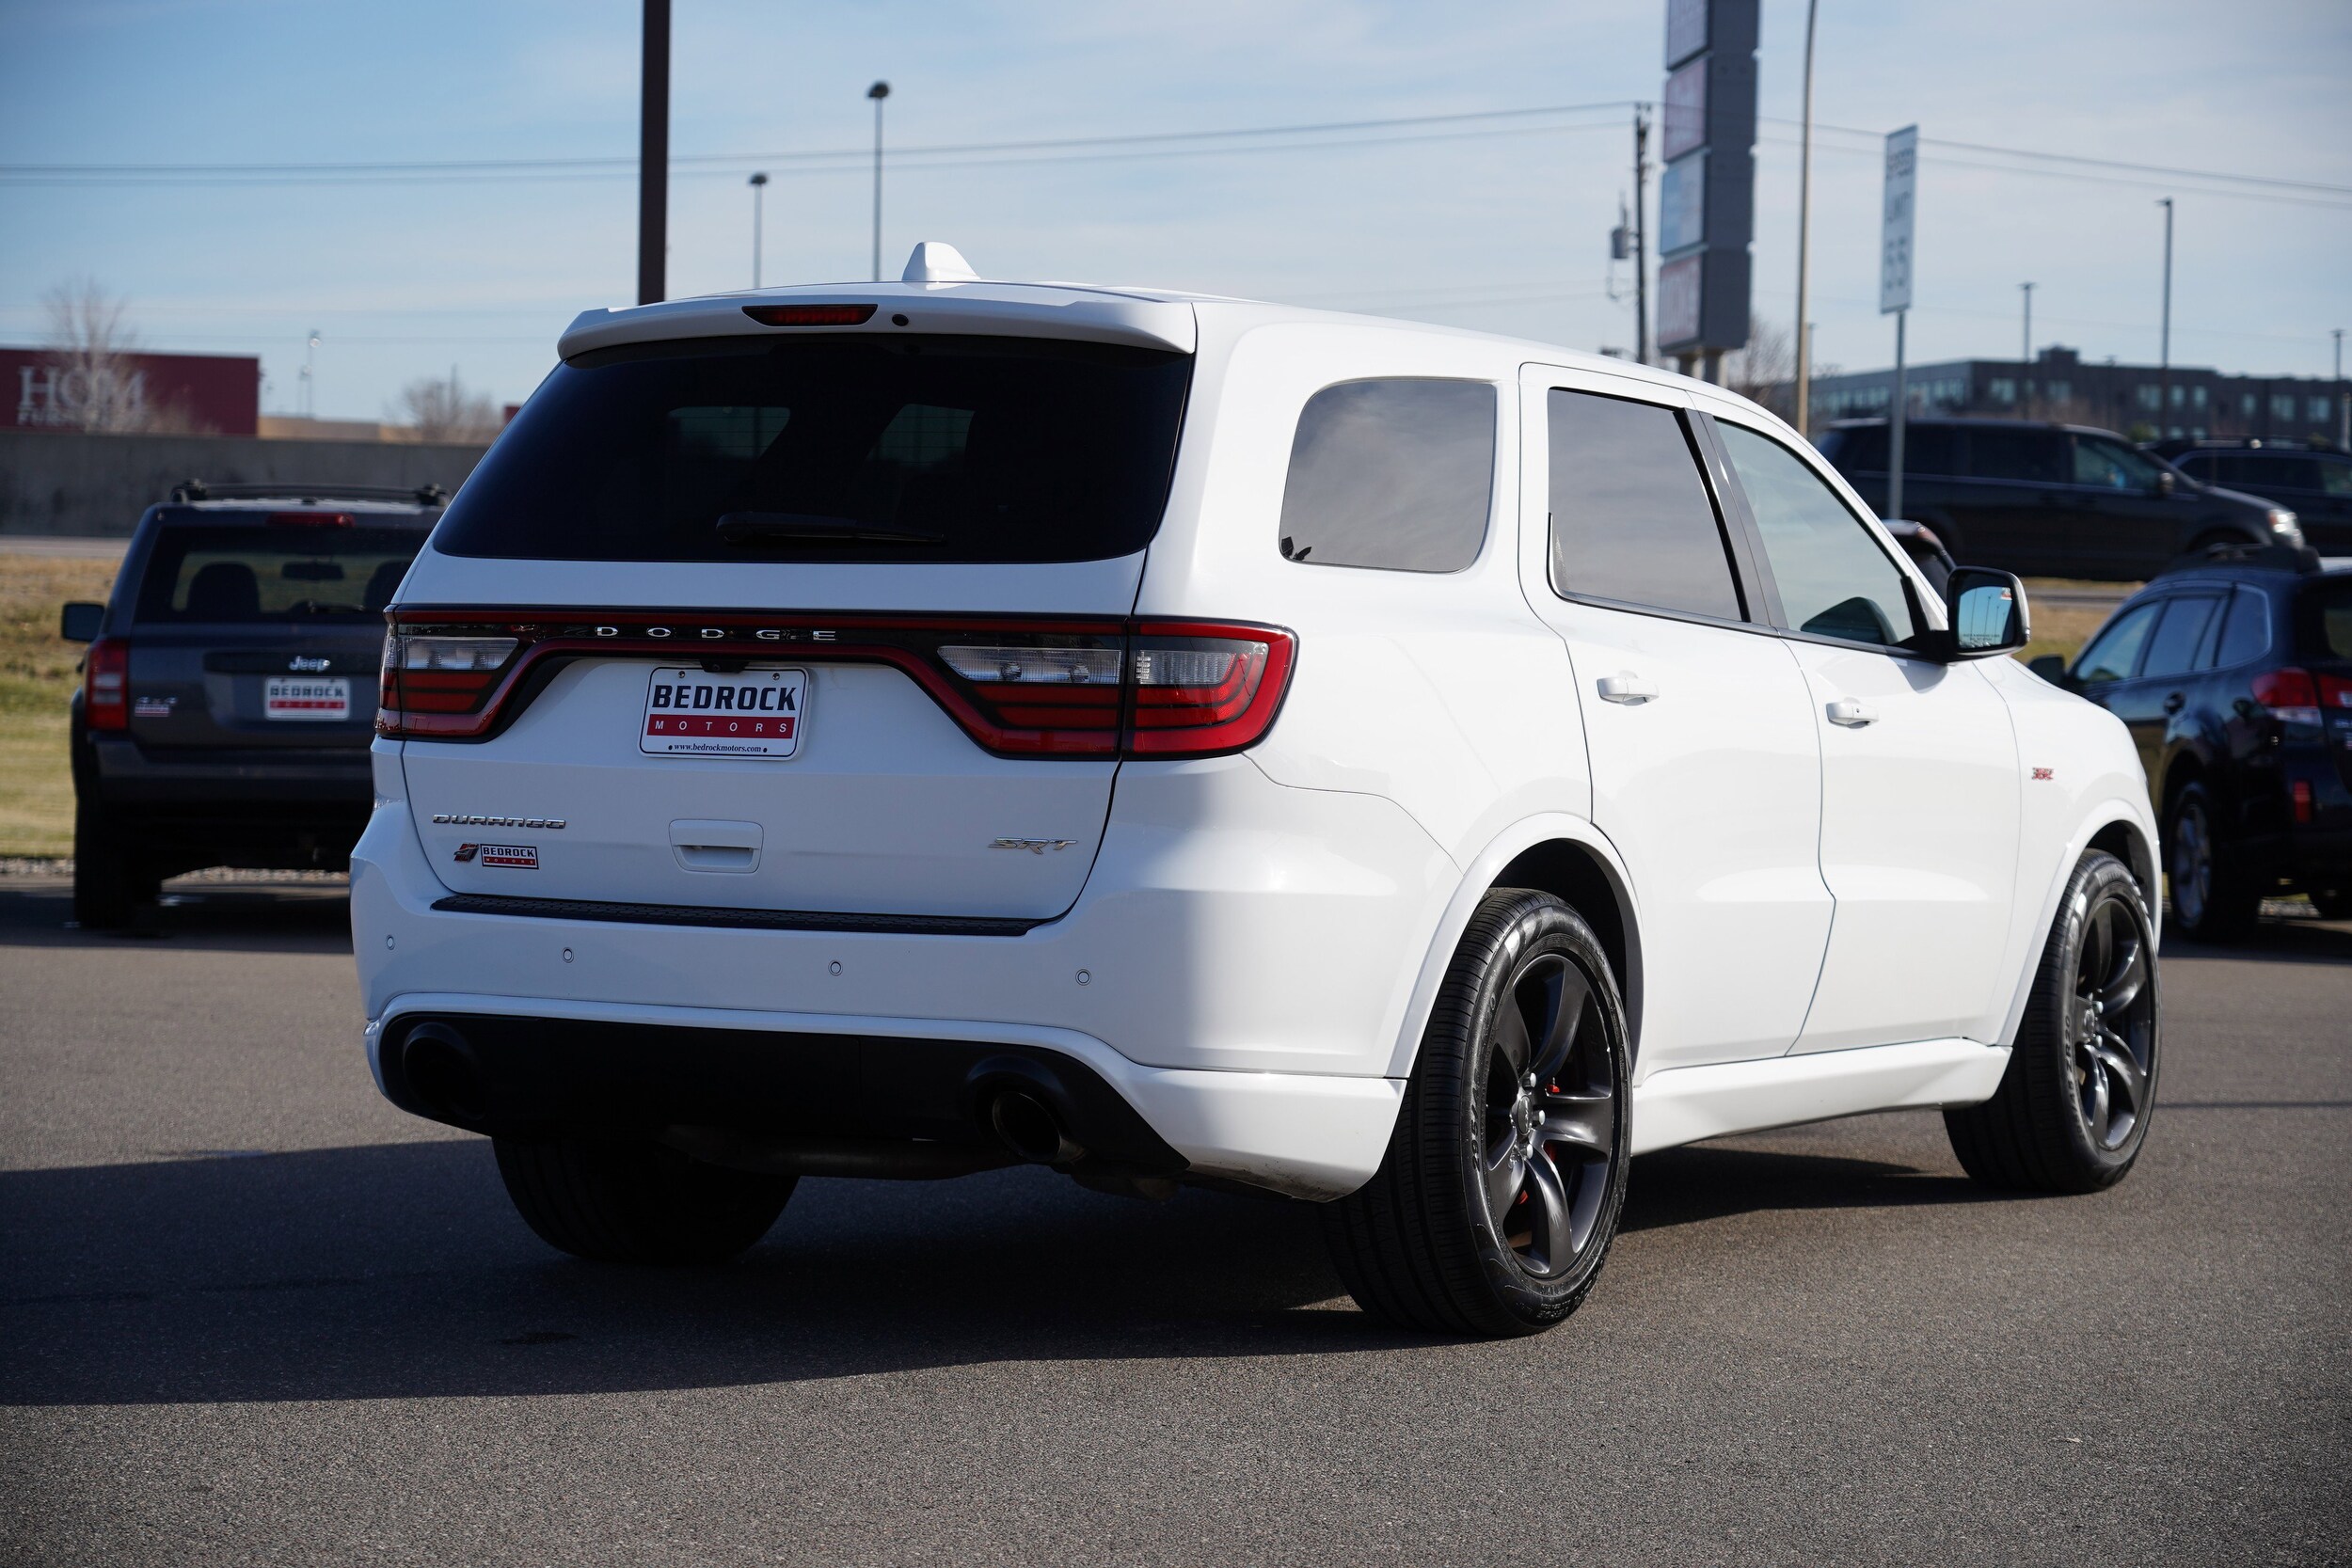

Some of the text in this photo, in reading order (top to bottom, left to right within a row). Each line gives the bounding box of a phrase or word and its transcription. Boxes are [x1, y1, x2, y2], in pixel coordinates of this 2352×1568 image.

[596, 626, 836, 641] DODGE
[289, 656, 330, 672] Jeep
[270, 685, 344, 697] BEDROCK
[652, 685, 797, 711] BEDROCK
[655, 721, 787, 733] MOTORS
[674, 743, 762, 752] www.bedrockmotors.com
[433, 814, 566, 830] DURANGO
[483, 847, 535, 858] BEDROCK
[988, 837, 1078, 855] SRT
